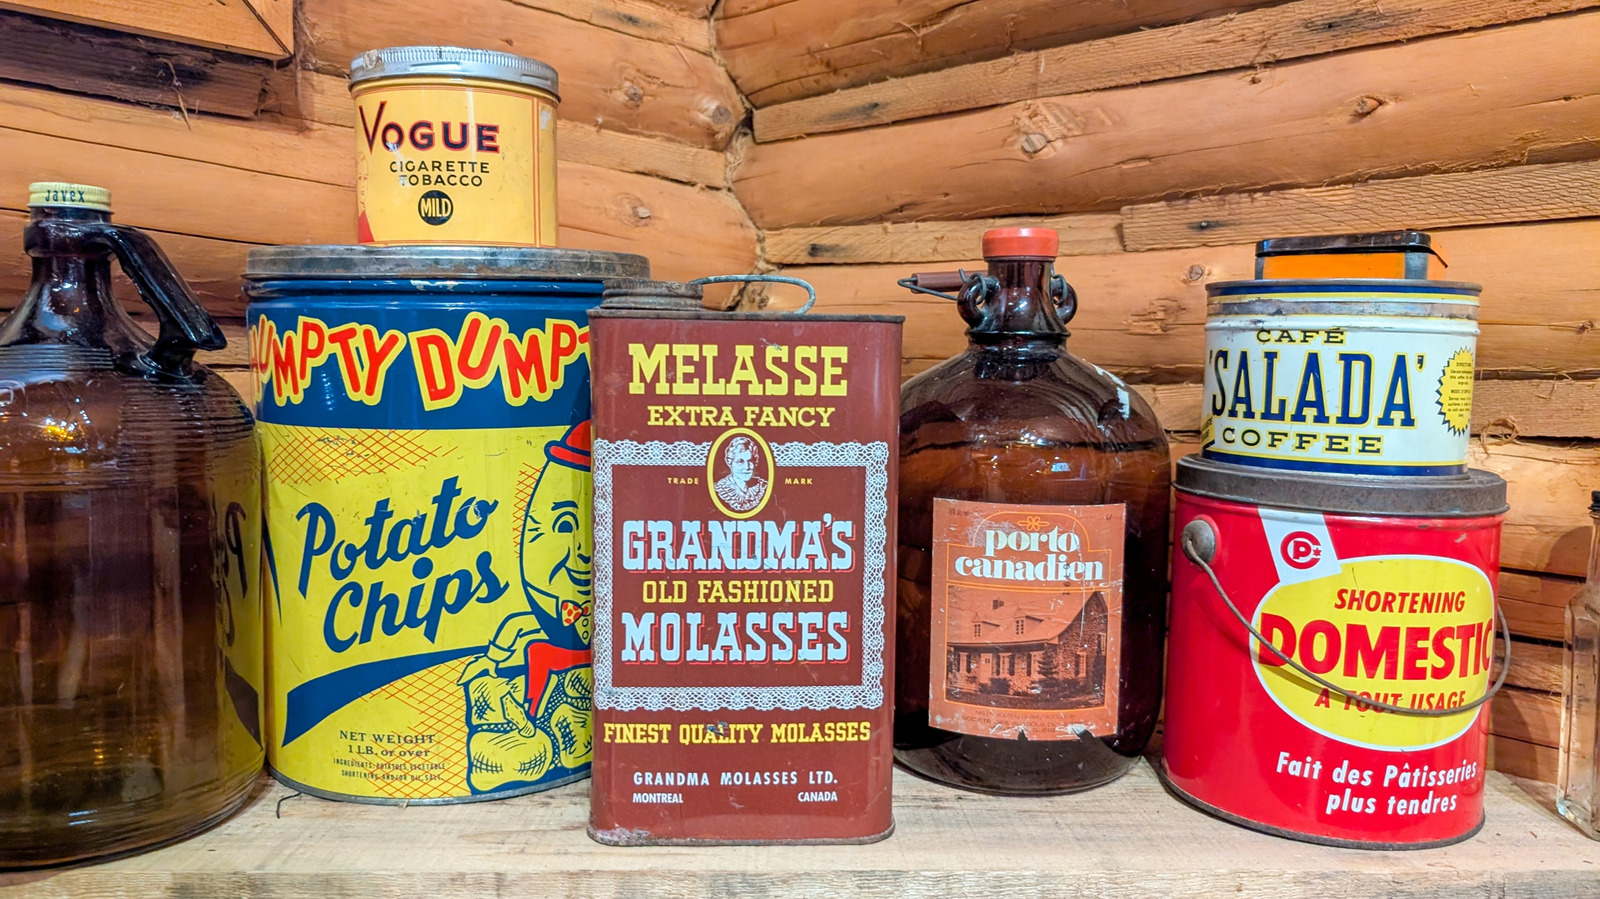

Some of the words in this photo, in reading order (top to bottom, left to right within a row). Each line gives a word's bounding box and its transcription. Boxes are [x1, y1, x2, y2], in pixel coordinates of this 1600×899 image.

[359, 101, 500, 155] VOGUE
[390, 160, 490, 174] CIGARETTE
[399, 174, 483, 187] TOBACCO
[420, 198, 451, 218] MILD
[1256, 328, 1345, 344] CAFÉ
[628, 343, 848, 396] MELASSE
[648, 405, 737, 426] EXTRA
[744, 406, 835, 427] FANCY
[1222, 427, 1383, 454] COFFEE
[667, 477, 699, 485] TRADE
[785, 477, 813, 485] MARK
[295, 475, 499, 600] Potato
[622, 513, 856, 573] GRANDMA'S
[984, 526, 1080, 557] porto
[955, 554, 1104, 581] canadien
[323, 551, 509, 653] Chips
[642, 580, 688, 603] OLD
[698, 579, 834, 603] FASHIONED
[1334, 588, 1466, 614] SHORTENING
[621, 611, 851, 665] MOLASSES
[1258, 612, 1493, 681] DOMESTIC
[1344, 690, 1402, 714] TOUT
[339, 729, 367, 742] NET
[372, 734, 436, 744] WEIGHT
[603, 722, 672, 744] FINEST
[679, 722, 764, 745] QUALITY
[770, 721, 871, 743] MOLASSES
[381, 749, 395, 757] or
[399, 749, 431, 757] over
[633, 771, 710, 786] GRANDMA
[720, 771, 798, 785] MOLASSES
[808, 770, 838, 784] LTD.
[1276, 751, 1323, 780] Fait
[1332, 760, 1374, 787] des
[1383, 759, 1477, 788] Pâtisseries
[632, 792, 684, 804] MONTREAL
[797, 791, 838, 802] CANADA
[1326, 788, 1377, 815] plus
[1387, 790, 1457, 815] tendres
